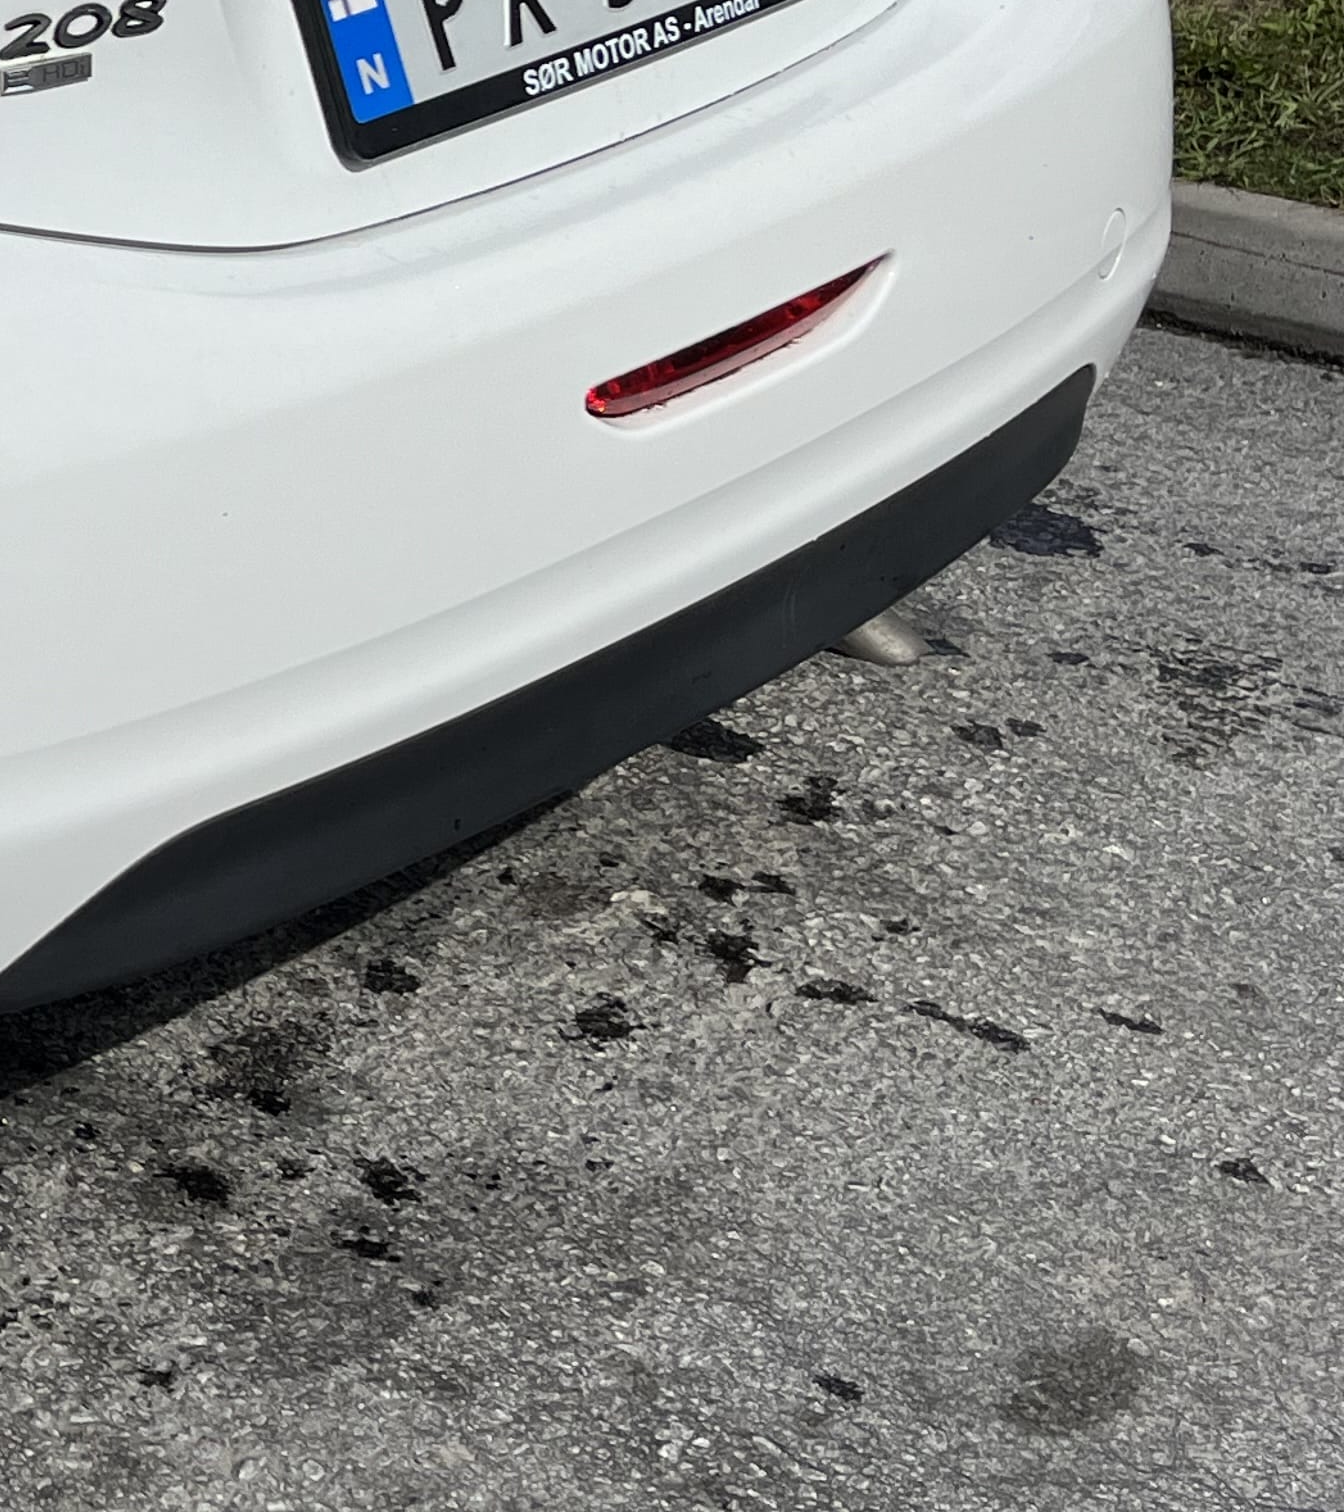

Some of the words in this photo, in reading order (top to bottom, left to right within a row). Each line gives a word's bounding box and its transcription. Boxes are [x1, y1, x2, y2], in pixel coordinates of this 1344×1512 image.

[355, 52, 391, 96] N
[522, 57, 574, 96] SØR
[573, 28, 652, 78] MOTOR
[653, 15, 682, 48] AS
